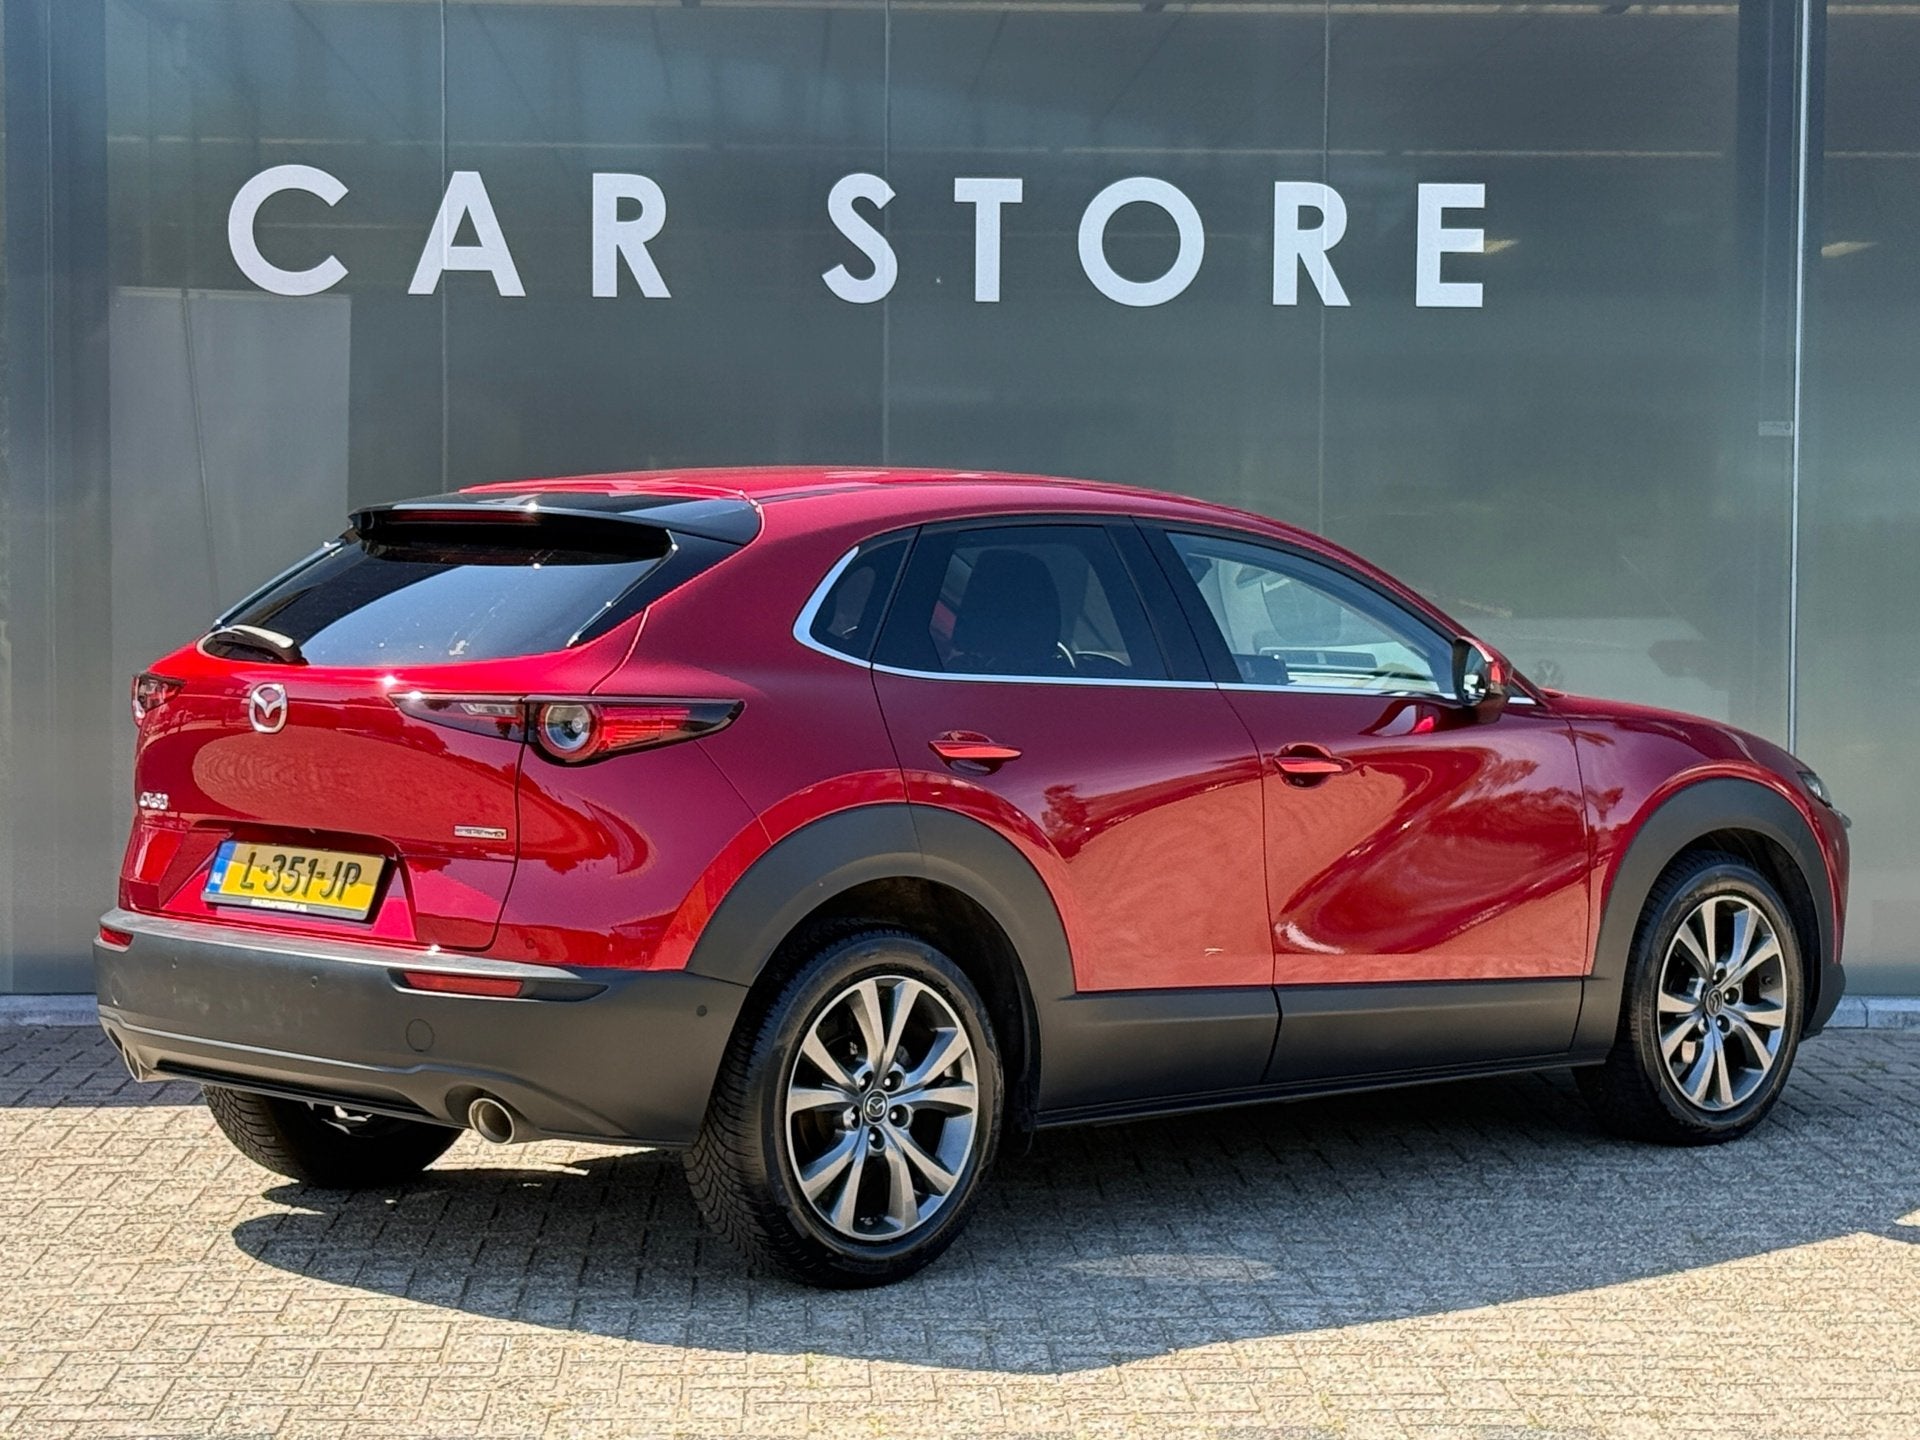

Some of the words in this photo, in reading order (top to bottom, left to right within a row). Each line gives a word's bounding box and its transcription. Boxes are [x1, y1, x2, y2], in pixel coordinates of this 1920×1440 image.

[228, 164, 671, 297] CAR
[822, 173, 1486, 307] STORE
[240, 851, 362, 901] L-351-JP
